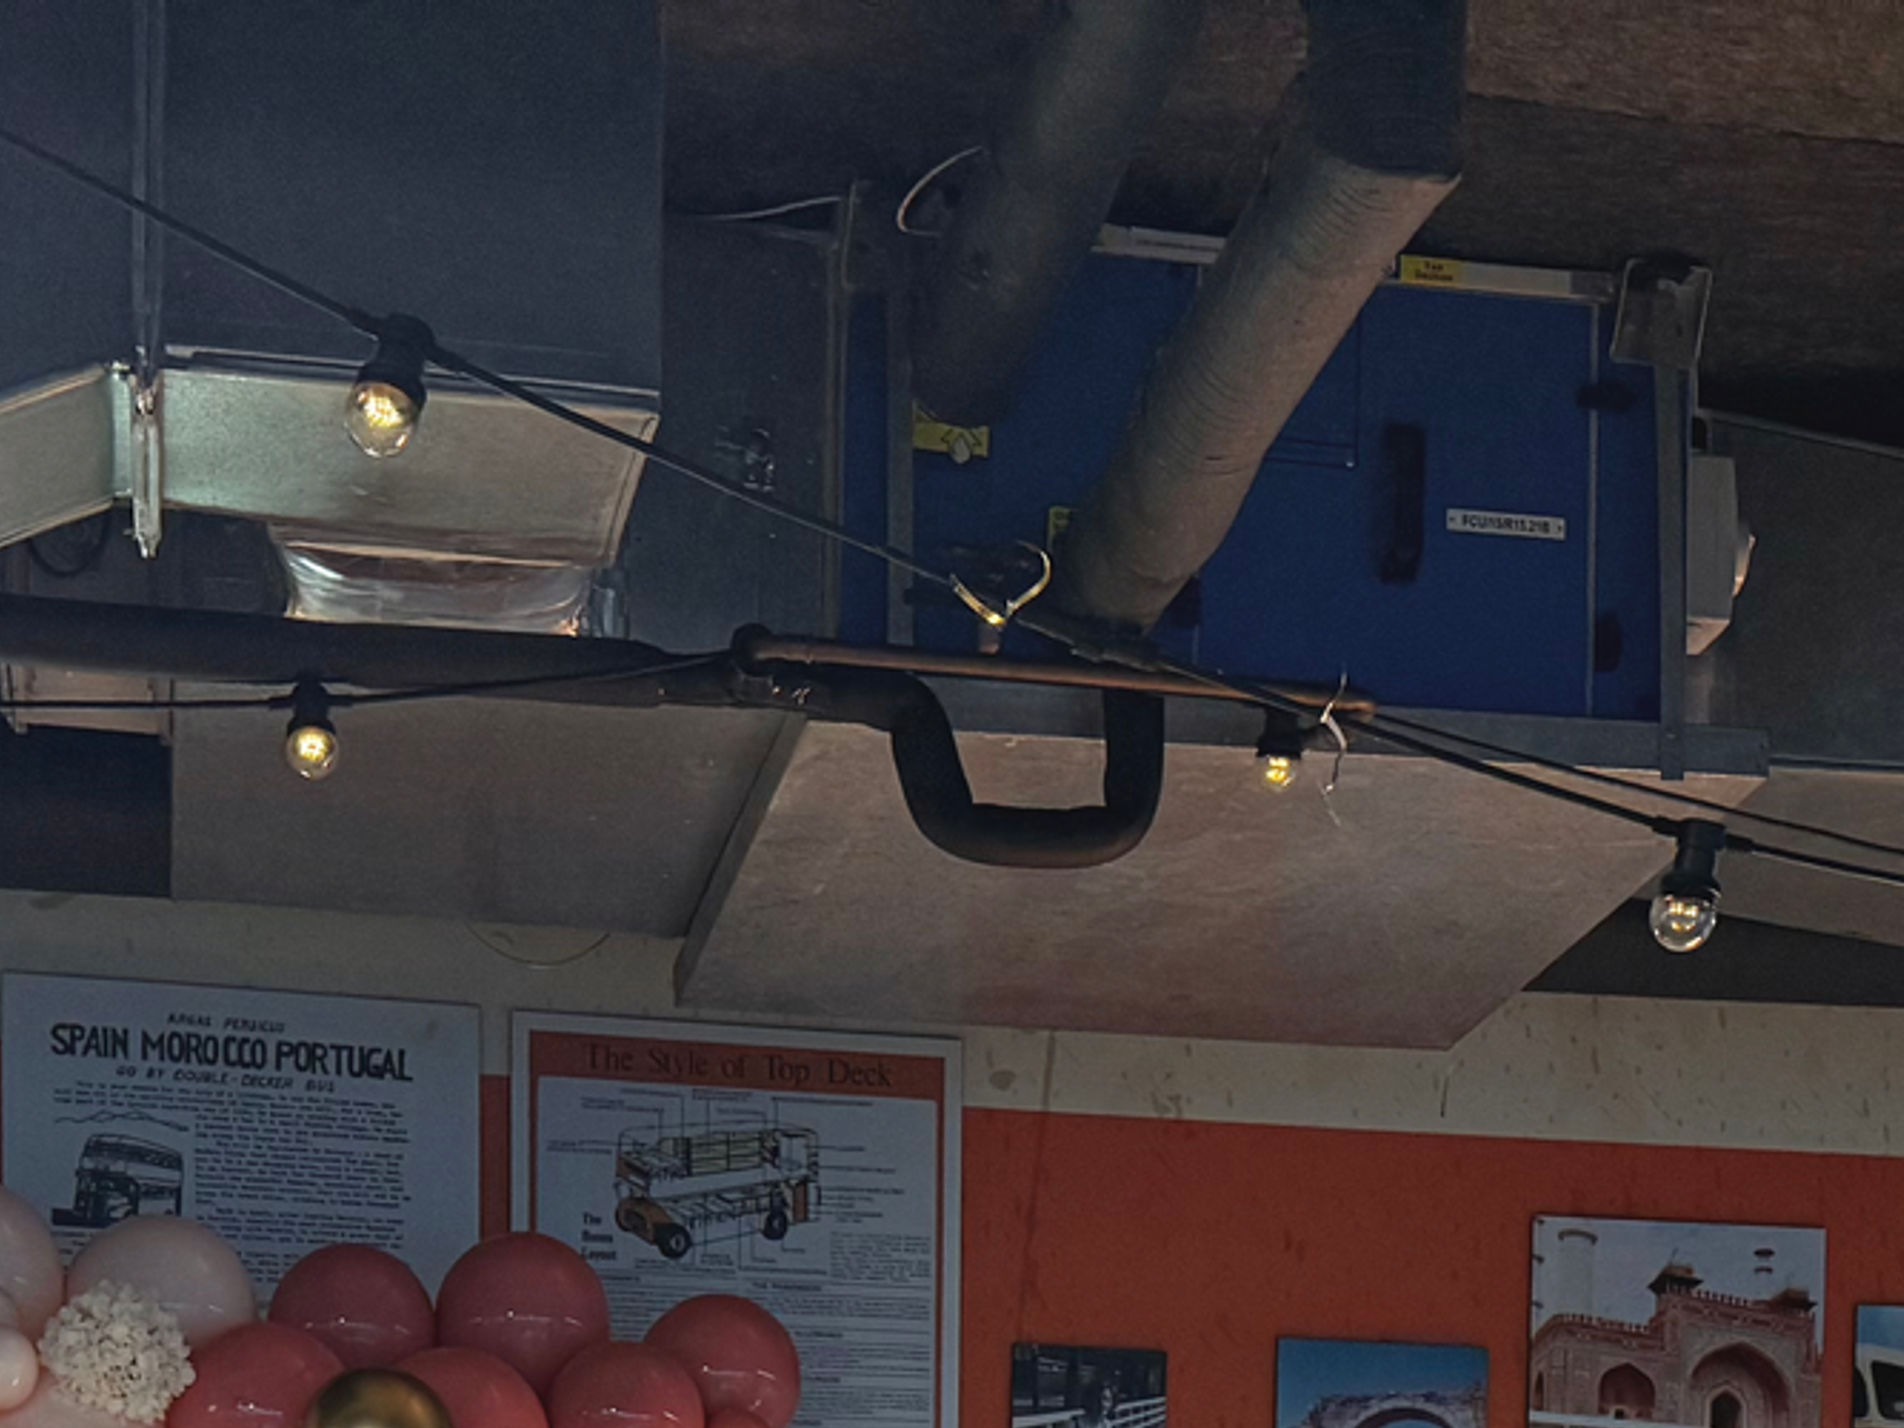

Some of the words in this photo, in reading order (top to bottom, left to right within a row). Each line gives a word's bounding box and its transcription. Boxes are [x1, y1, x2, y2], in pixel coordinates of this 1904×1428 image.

[49, 1022, 129, 1061] SPAIN
[140, 1029, 268, 1070] MOROCCO
[274, 1039, 414, 1083] PORTUGAL
[588, 1042, 634, 1072] The
[647, 1046, 708, 1079] Style
[720, 1051, 748, 1080] of
[767, 1054, 811, 1086] Top
[827, 1056, 894, 1088] Deck
